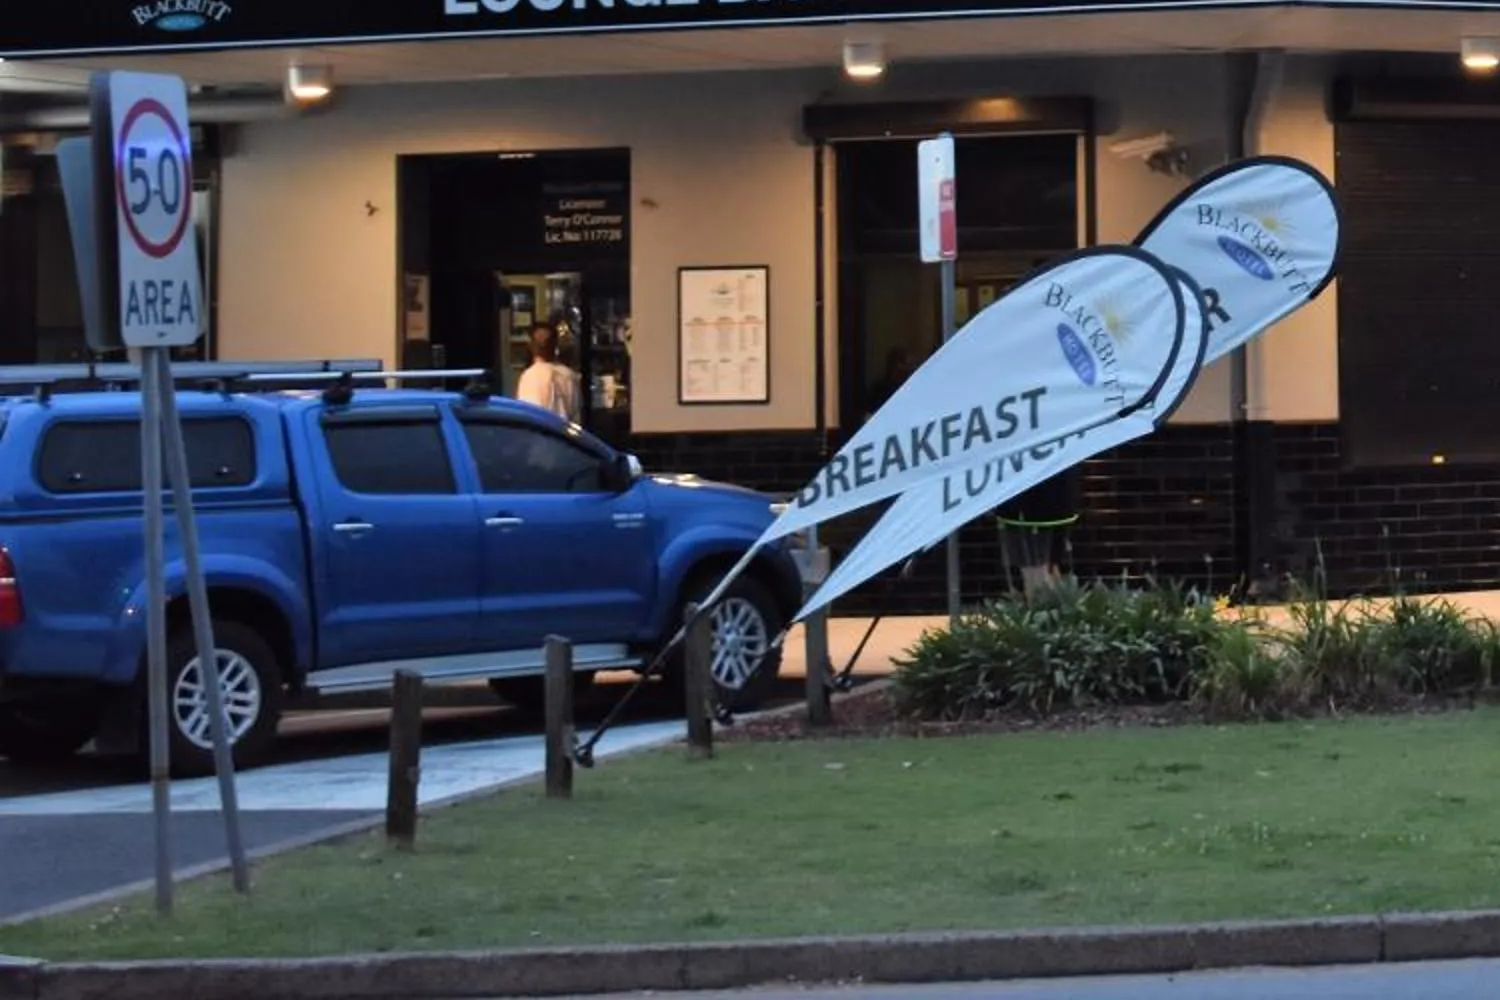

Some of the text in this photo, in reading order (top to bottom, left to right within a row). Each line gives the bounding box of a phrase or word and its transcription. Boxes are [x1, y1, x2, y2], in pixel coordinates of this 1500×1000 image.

[128, 146, 181, 215] 50
[1198, 203, 1312, 294] BLACKBUTT
[125, 279, 196, 327] AREA
[1044, 282, 1126, 407] BLACKBUTT
[797, 386, 1048, 509] BREAKFAST
